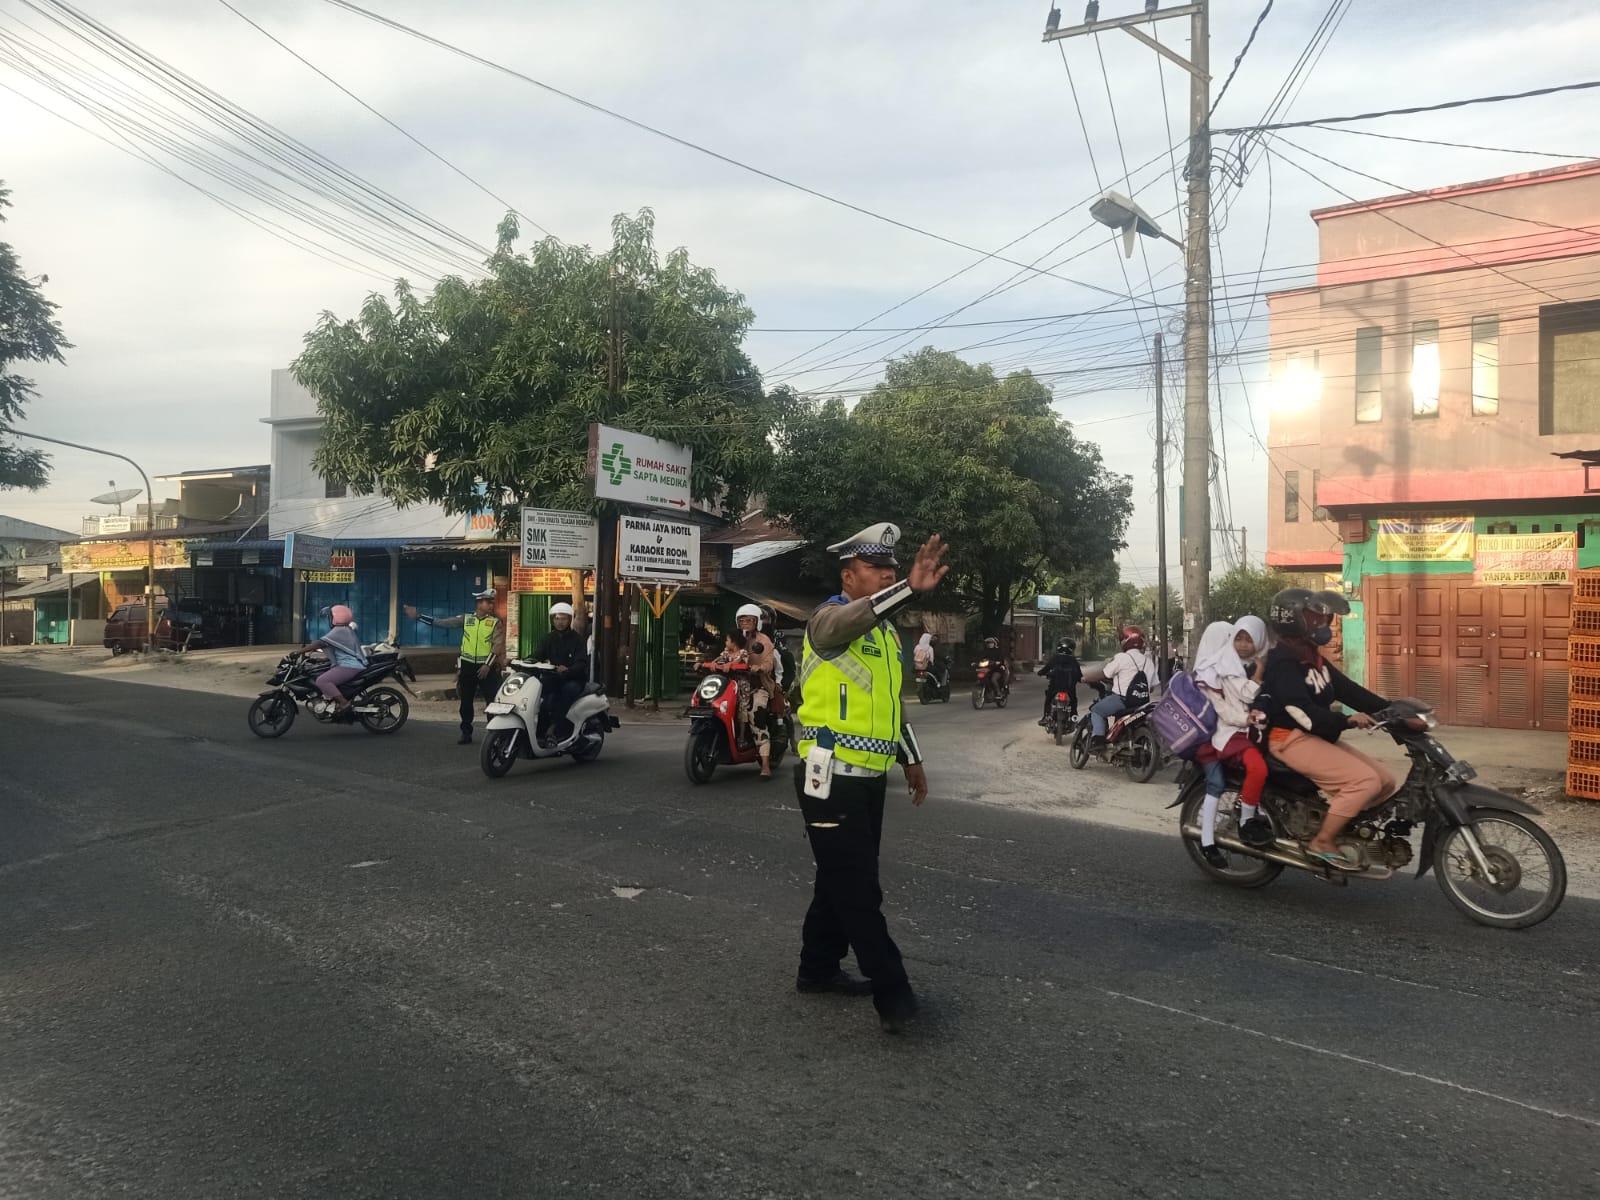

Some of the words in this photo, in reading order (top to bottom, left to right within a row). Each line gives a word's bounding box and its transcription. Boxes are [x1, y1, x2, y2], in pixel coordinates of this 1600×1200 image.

[636, 457, 664, 471] RUMAH
[665, 462, 687, 475] SAKIT
[633, 470, 658, 483] SAPTA
[660, 476, 688, 488] MEDIKA
[527, 528, 547, 542] SMK
[625, 520, 651, 531] PARNA
[652, 523, 670, 534] JAYA
[671, 525, 691, 536] HOTEL
[656, 535, 663, 544] &
[1477, 538, 1498, 550] RUKO
[1502, 538, 1513, 550] INI
[527, 547, 547, 560] SMA
[630, 544, 664, 556] KARAOKE
[666, 547, 688, 558] ROOM
[1483, 572, 1511, 581] TANPA
[1513, 571, 1567, 580] PERANTARA
